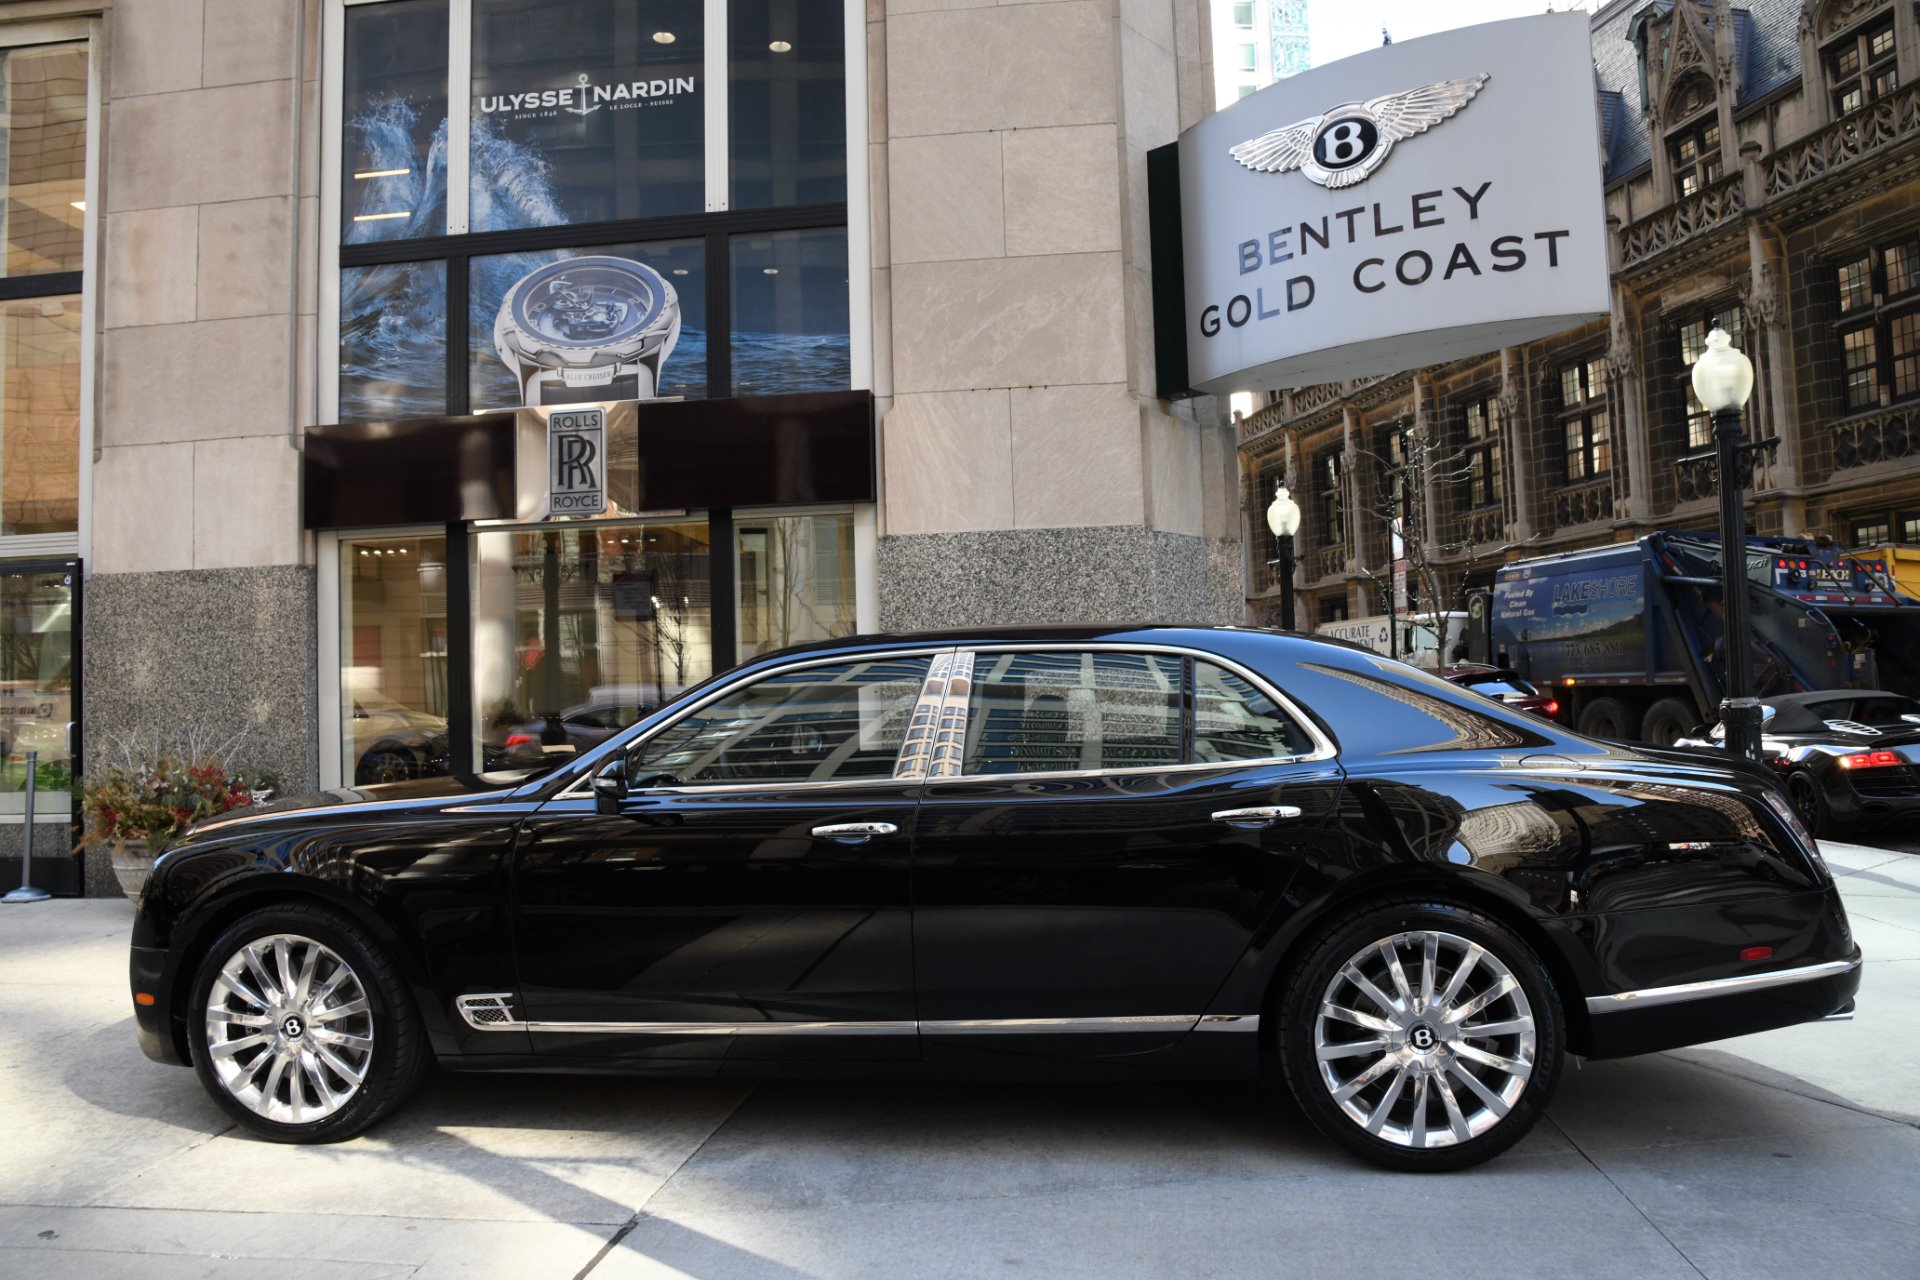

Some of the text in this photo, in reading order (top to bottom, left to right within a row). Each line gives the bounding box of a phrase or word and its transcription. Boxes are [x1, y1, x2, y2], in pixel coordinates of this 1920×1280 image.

[480, 76, 695, 113] ULYSSE NARDIN
[514, 112, 537, 120] SINCE
[1324, 120, 1364, 164] B
[1238, 181, 1493, 276] BENTLEY
[1200, 229, 1570, 338] GOLD COAST
[553, 414, 598, 429] ROLLS
[553, 494, 599, 509] ROYCE
[1504, 589, 1535, 599] Fueled By
[1553, 575, 1638, 602] LAKESHORE
[1501, 608, 1535, 619] Natural Gas
[1329, 625, 1370, 640] ACCURATE
